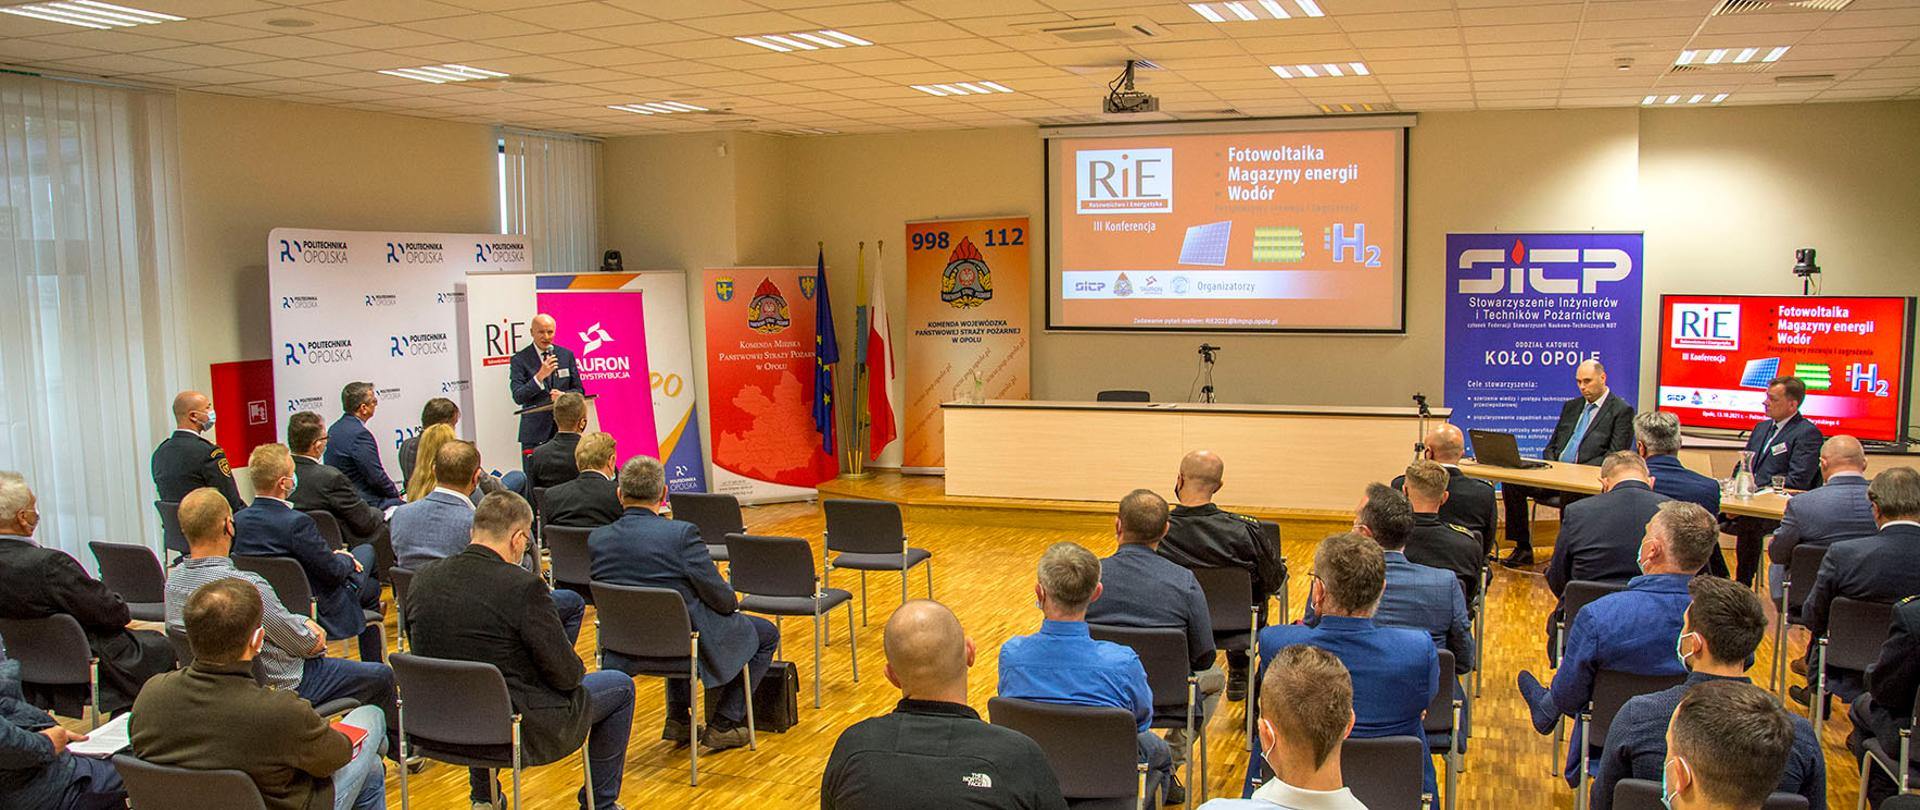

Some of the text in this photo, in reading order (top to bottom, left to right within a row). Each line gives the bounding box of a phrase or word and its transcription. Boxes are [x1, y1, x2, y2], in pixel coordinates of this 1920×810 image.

[1228, 145, 1324, 162] Fotowoltaika
[1090, 154, 1161, 198] RiE
[1228, 164, 1358, 184] Magazyny energii
[1228, 185, 1275, 200] Wodór
[1094, 220, 1156, 233] III Konferencja
[912, 231, 950, 250] 998
[985, 228, 1024, 246] 112
[303, 240, 348, 250] POLITECHNIKA
[303, 250, 348, 264] OPOLSKA
[406, 251, 444, 264] OPOLSKA
[492, 251, 525, 262] OPOLSKA
[1197, 280, 1256, 293] Organizatorzy
[1468, 297, 1618, 310] Stowarzyszenie Inżynierów
[1475, 309, 1611, 320] i Techników Pożarnictwa
[1778, 305, 1849, 318] Fotowoltaika
[1681, 307, 1732, 338] RiE
[1778, 318, 1874, 335] Magazyny energii
[410, 333, 447, 342] POLITECHNIKA
[1777, 332, 1812, 344] Wodór
[308, 340, 352, 350] POLITECHNIKA
[410, 342, 448, 356] OPOLSKA
[308, 349, 352, 364] OPOLSKA
[1485, 351, 1533, 365] KOŁO
[1690, 353, 1726, 364] Konferencja
[576, 356, 630, 372] AURON
[580, 372, 630, 380] DYSTRYBUCJA
[1485, 380, 1538, 388] stowarzyszenia:
